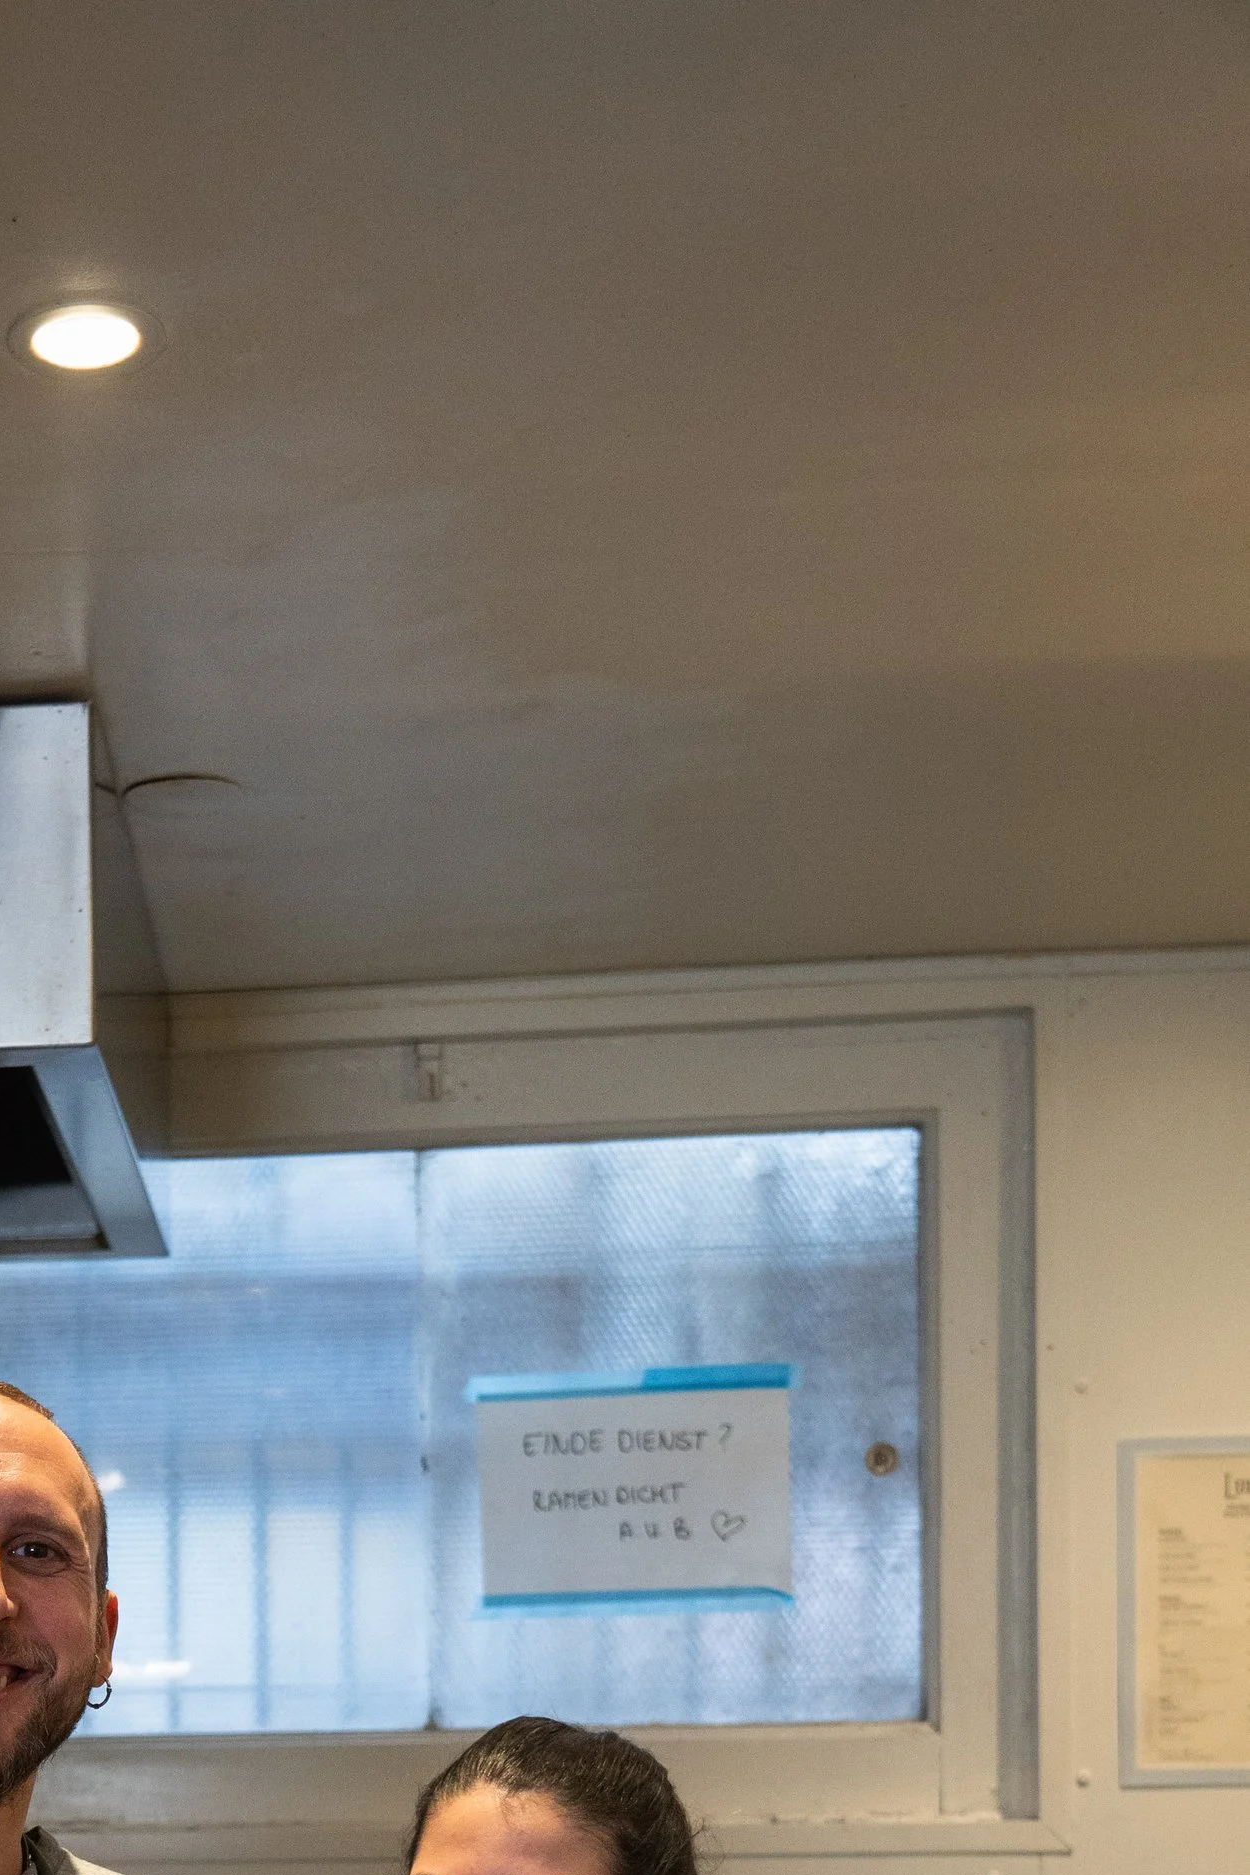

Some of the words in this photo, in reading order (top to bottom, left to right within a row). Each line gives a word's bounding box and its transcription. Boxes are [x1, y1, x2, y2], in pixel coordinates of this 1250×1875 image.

[523, 1429, 605, 1457] EINDE
[533, 1488, 608, 1512] RAMEN
[616, 1482, 686, 1505] DICHT
